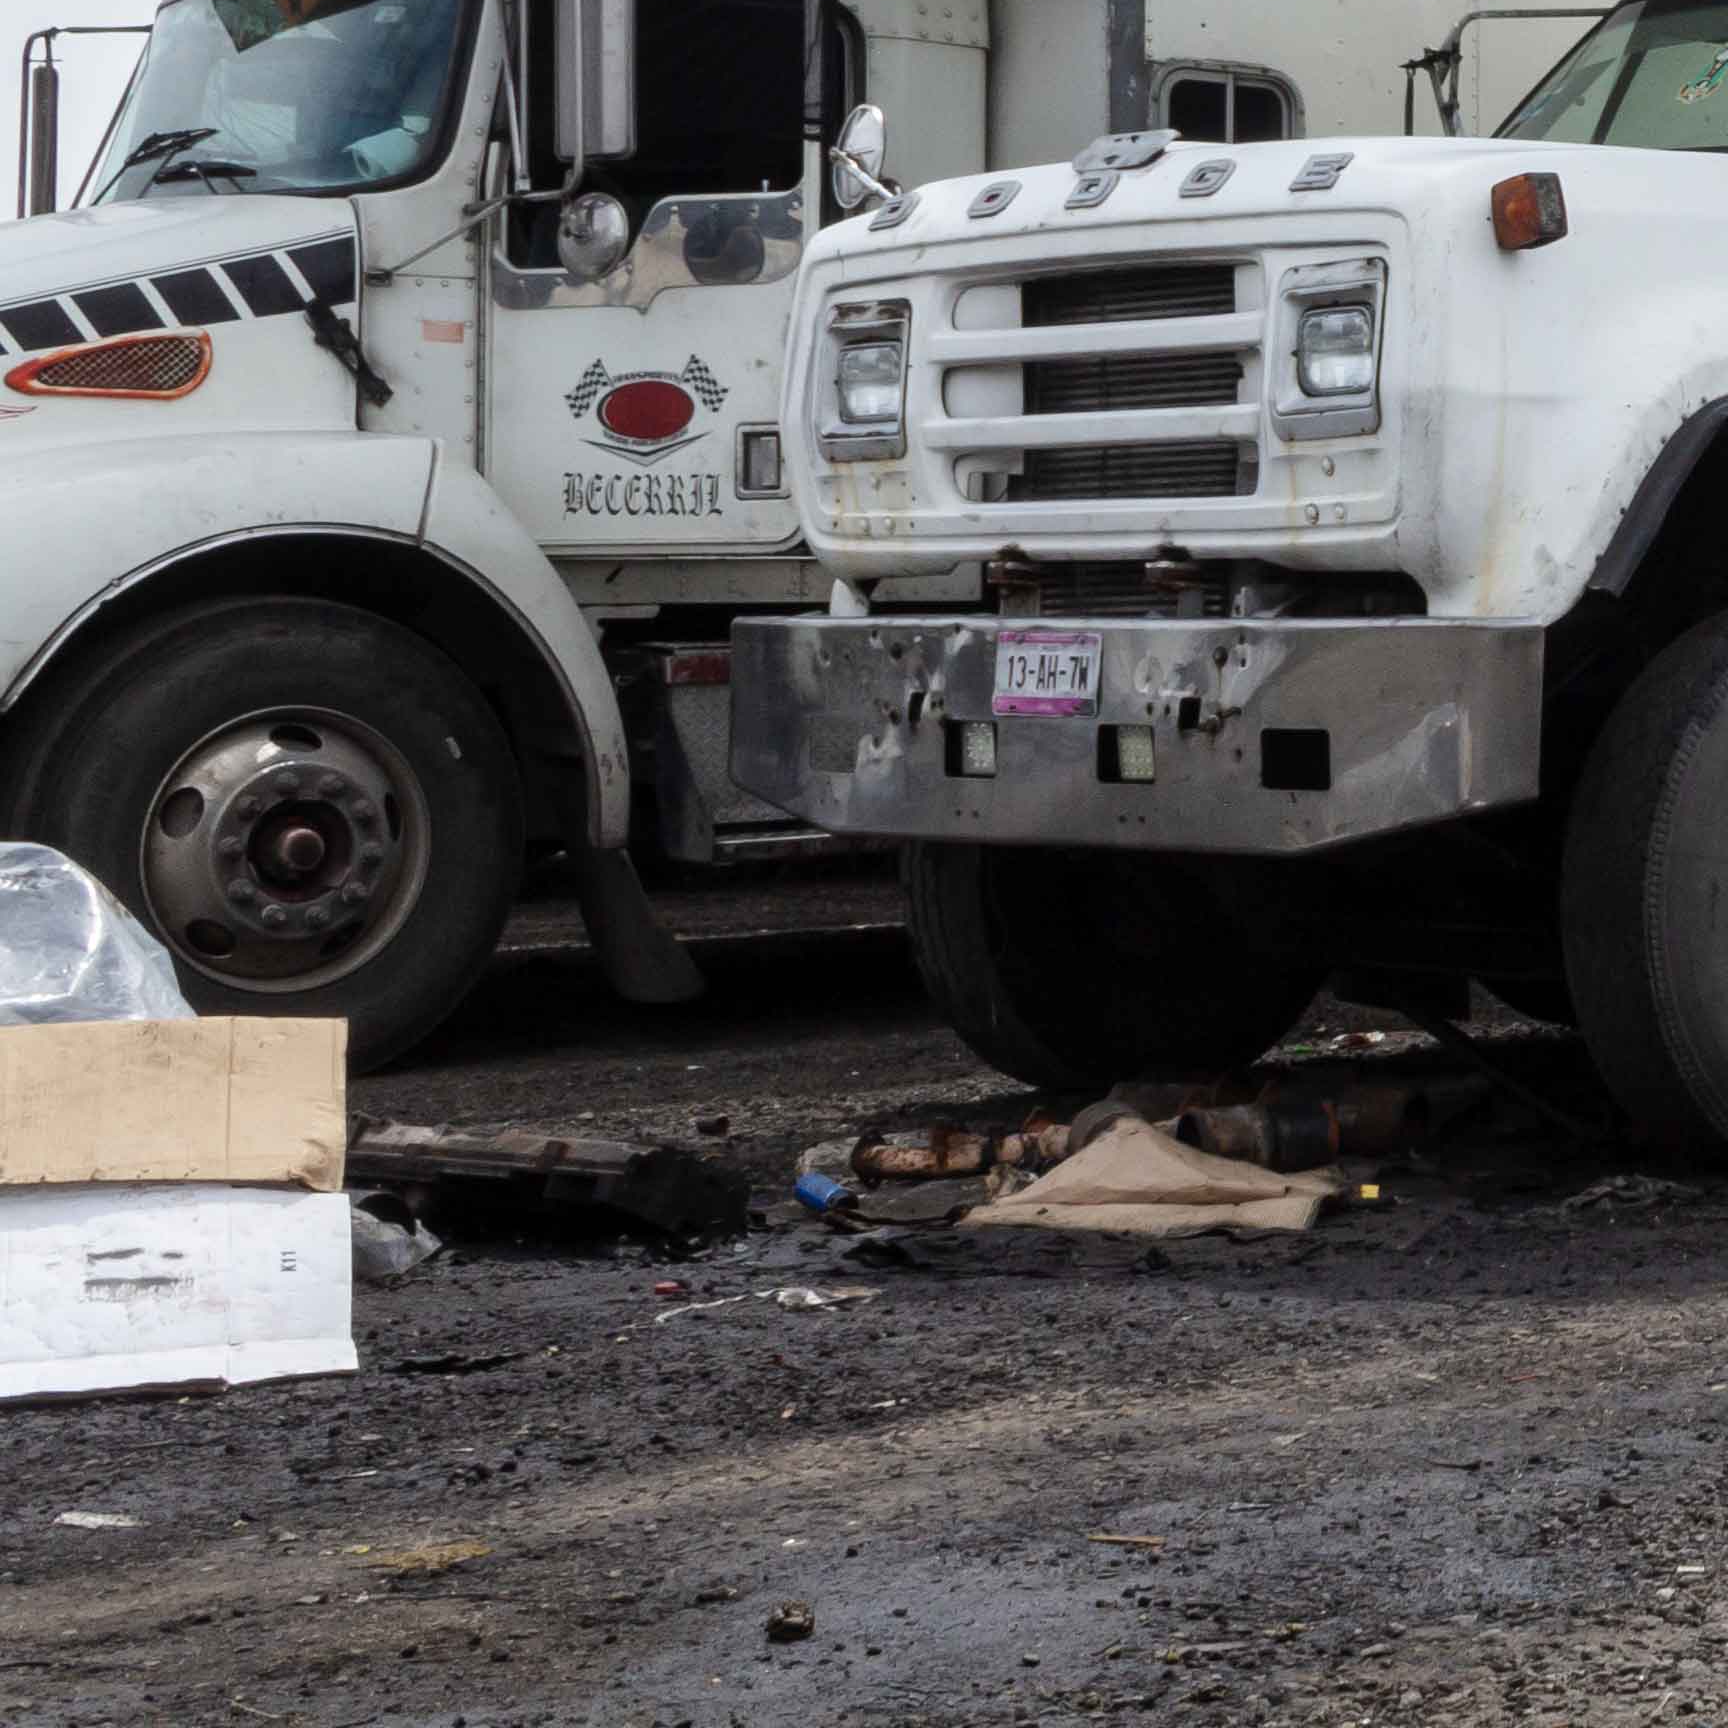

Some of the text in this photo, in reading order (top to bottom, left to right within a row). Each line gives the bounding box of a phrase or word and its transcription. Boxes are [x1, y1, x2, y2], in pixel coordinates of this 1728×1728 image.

[868, 151, 1355, 232] DODGE
[563, 472, 723, 520] BECERRIL
[1007, 654, 1089, 690] 13-AH-7W
[280, 1250, 297, 1272] K11
